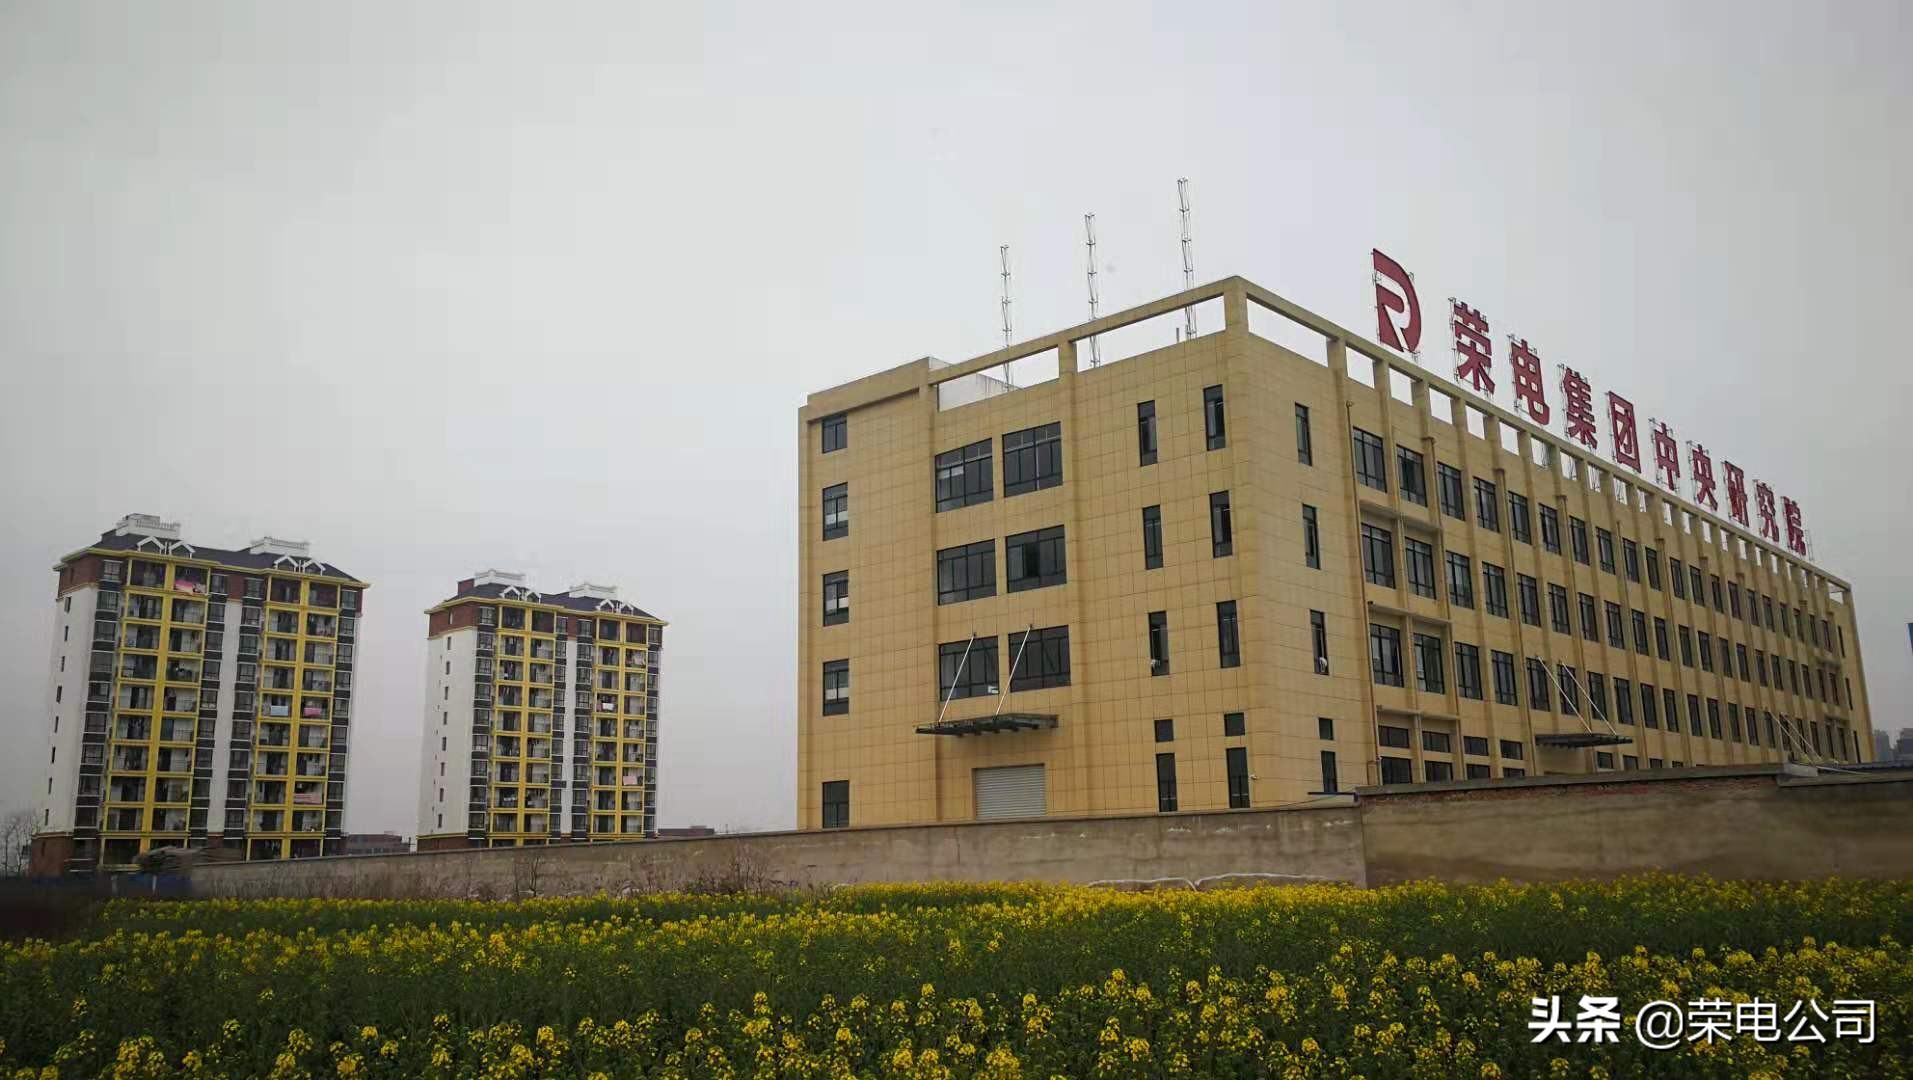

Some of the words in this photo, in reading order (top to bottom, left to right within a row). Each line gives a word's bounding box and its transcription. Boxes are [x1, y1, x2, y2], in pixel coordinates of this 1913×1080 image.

[1453, 300, 1807, 557] 荣电集团中央研究院
